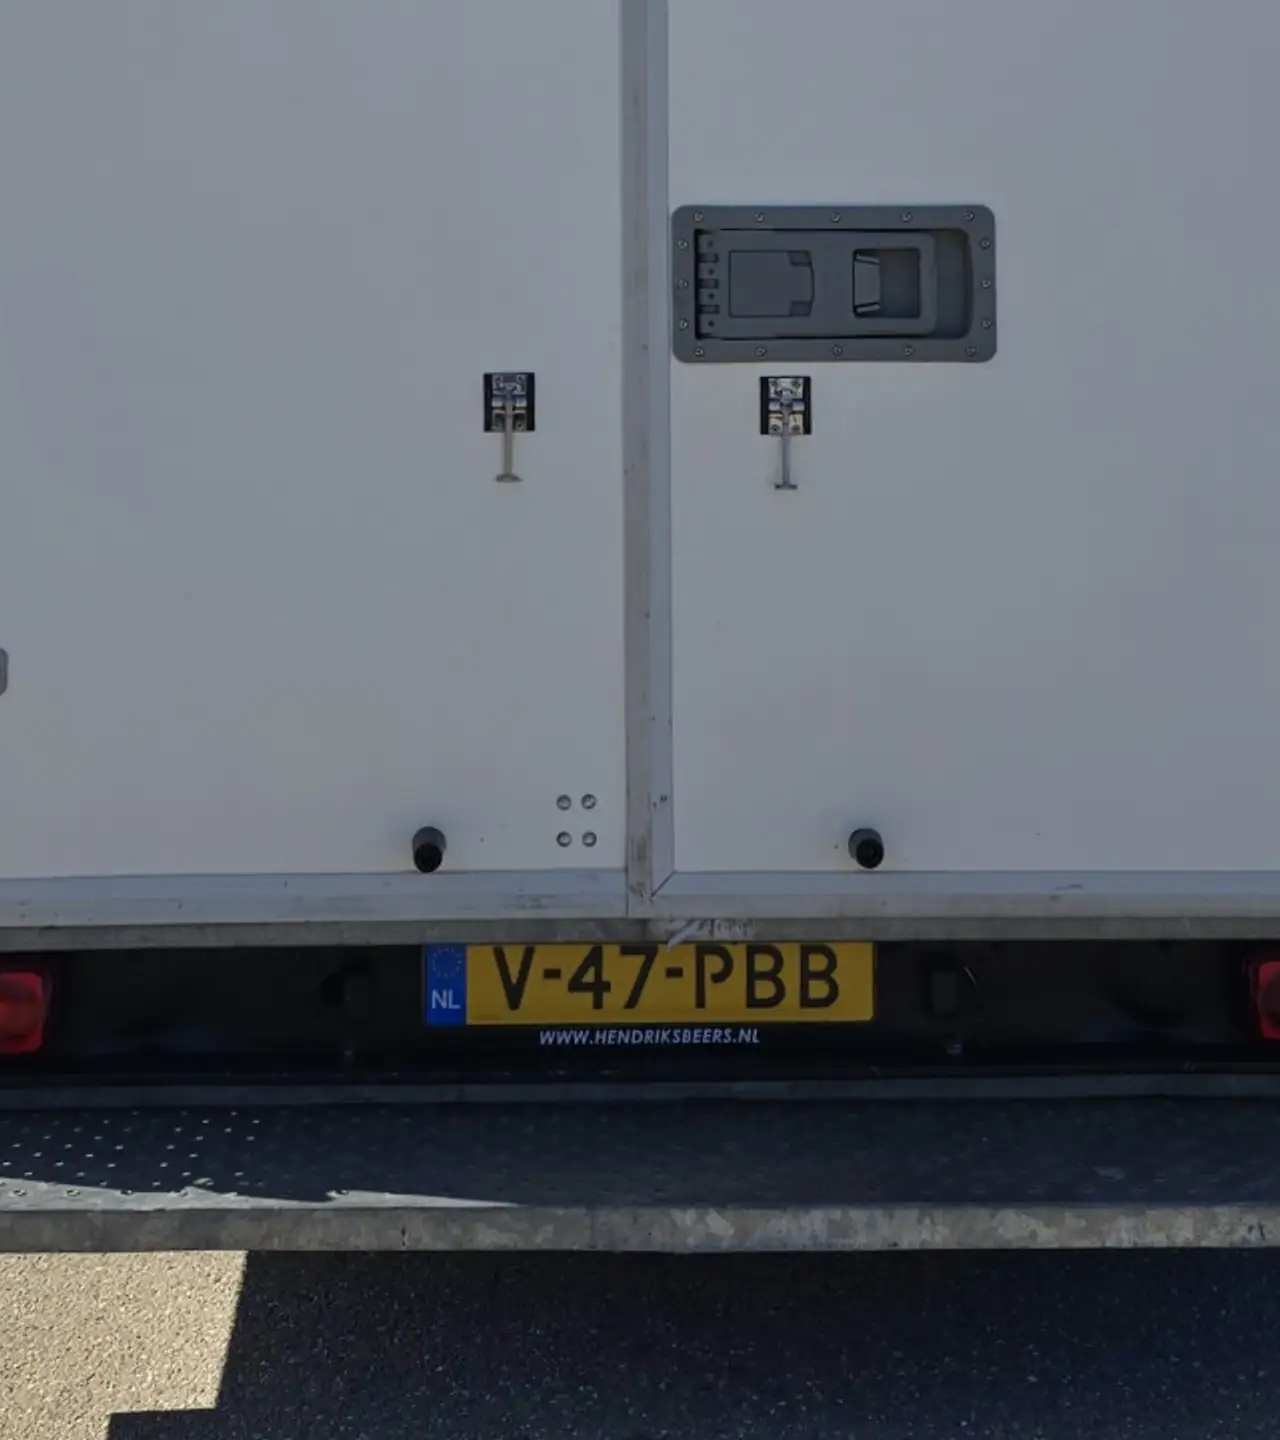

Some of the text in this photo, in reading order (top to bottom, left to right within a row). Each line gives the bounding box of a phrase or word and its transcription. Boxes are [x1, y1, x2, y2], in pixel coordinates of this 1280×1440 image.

[492, 945, 840, 1011] V-47-PBB
[431, 991, 461, 1009] NL
[539, 1028, 761, 1046] WWW.HENDRIKSBEERS.NL
